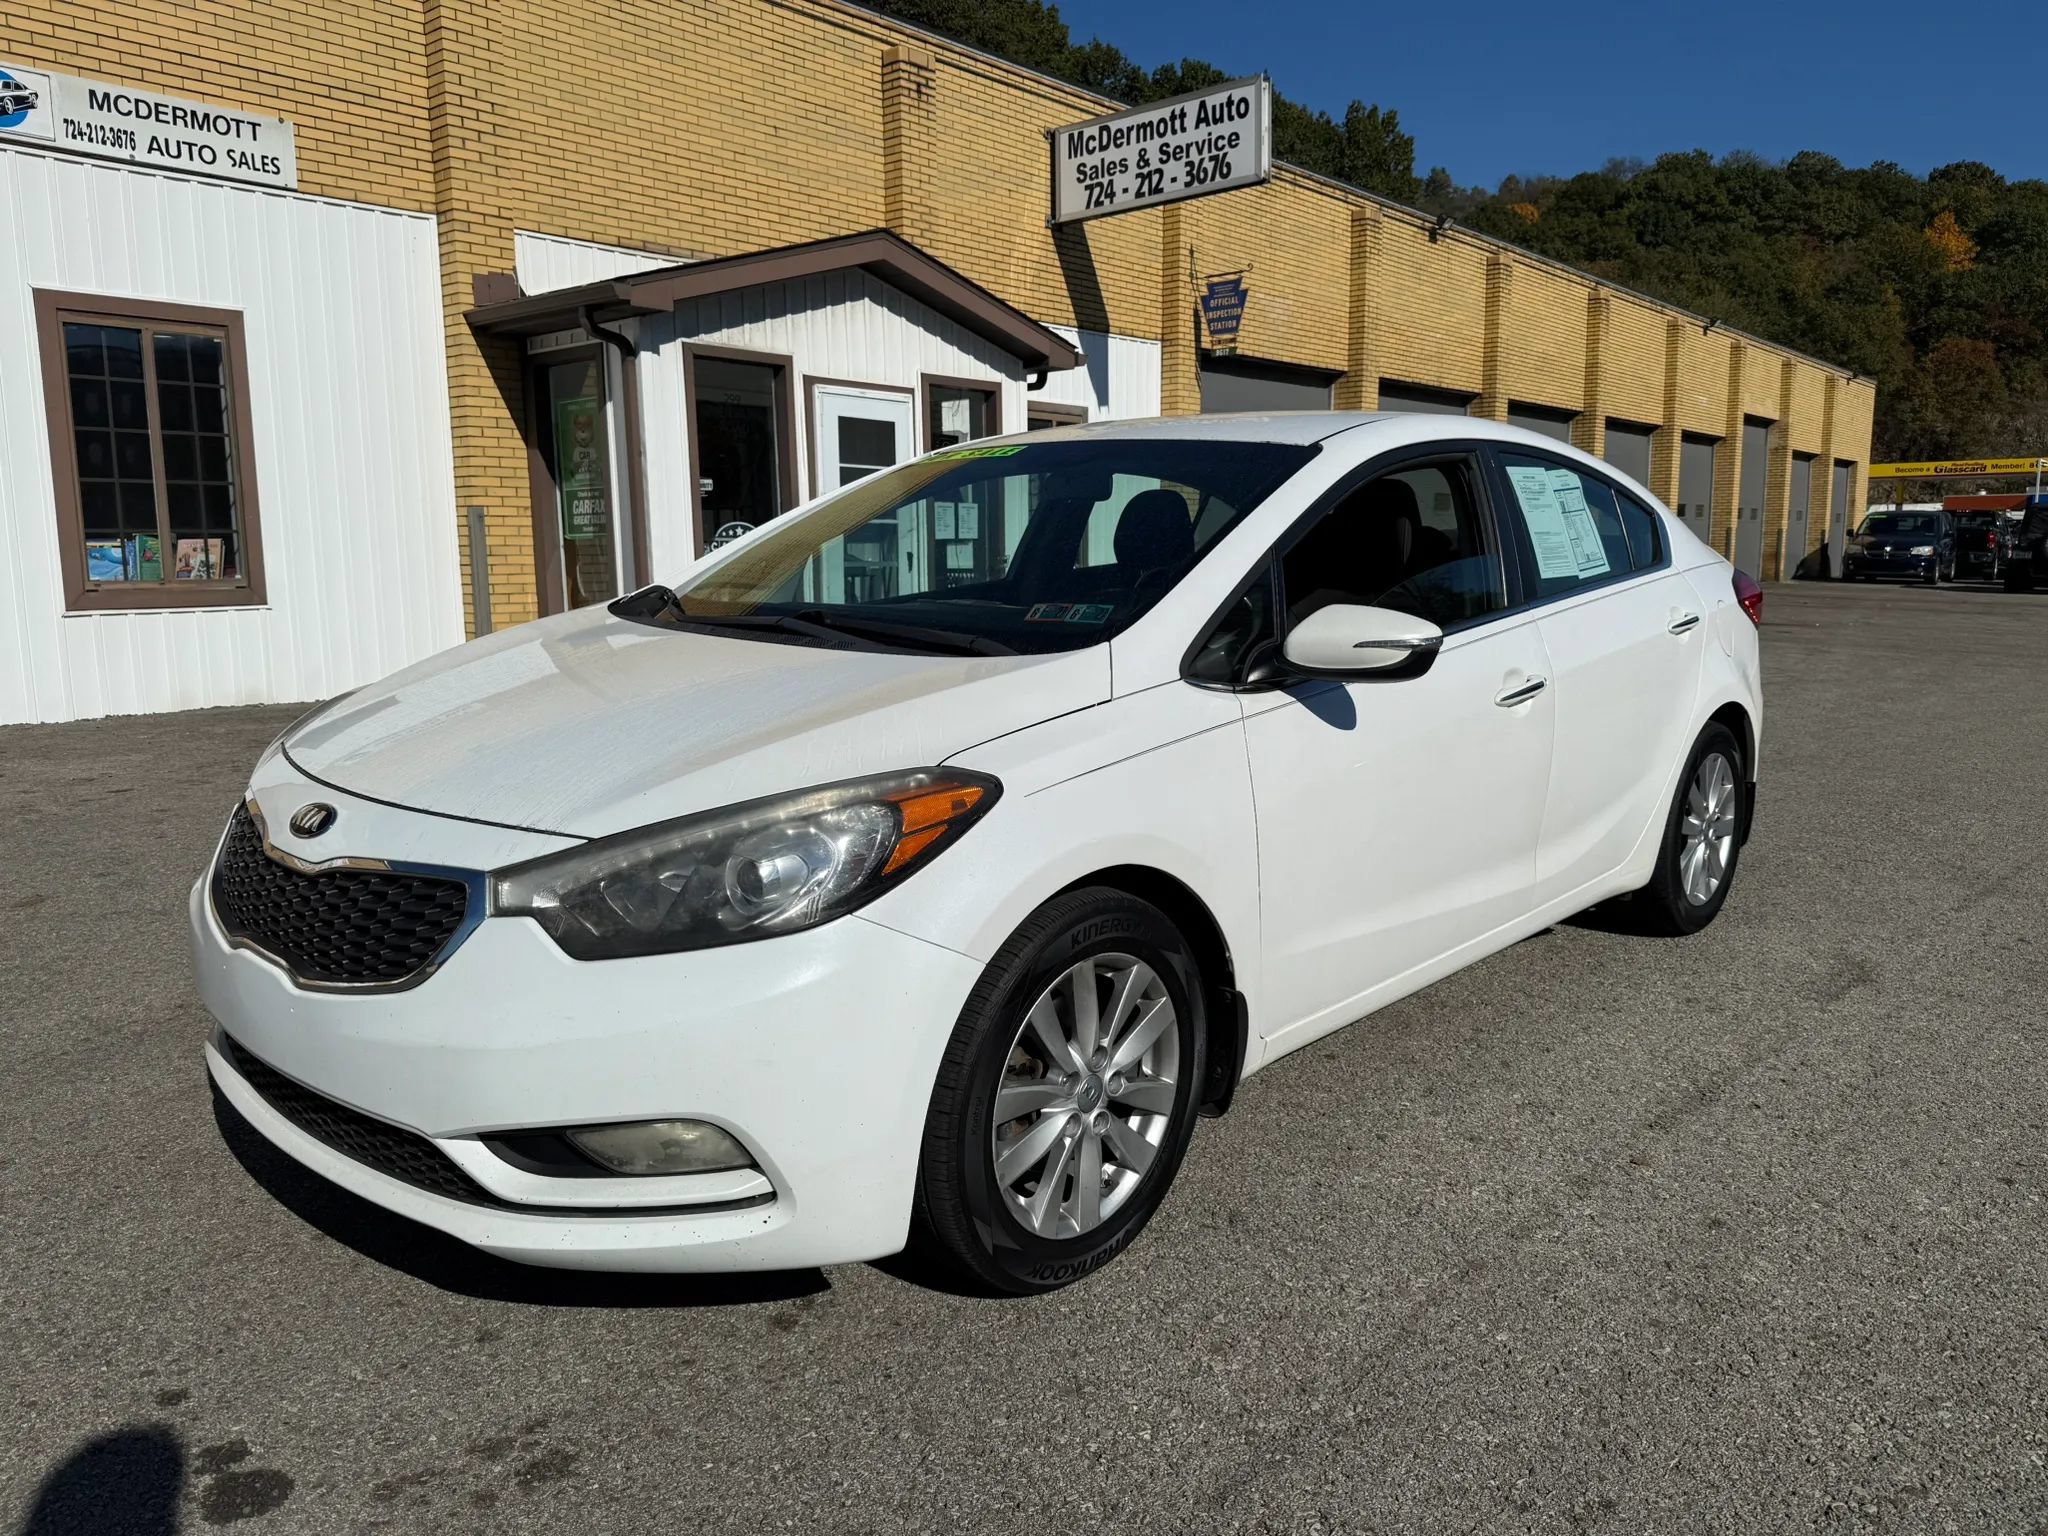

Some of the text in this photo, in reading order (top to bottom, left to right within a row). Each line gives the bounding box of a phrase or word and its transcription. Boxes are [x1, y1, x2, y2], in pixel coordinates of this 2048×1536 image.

[88, 88, 262, 141] MCDERMOTT
[1068, 93, 1250, 160] McDermott Auto
[63, 118, 137, 151] 724-212-3676
[147, 135, 281, 175] AUTO SALES
[1076, 131, 1241, 184] Sales & Service
[1205, 307, 1242, 319] INSPECTION
[1209, 295, 1239, 307] OFFICIAL
[1210, 319, 1237, 331] STATION
[572, 498, 606, 514] CARFAX
